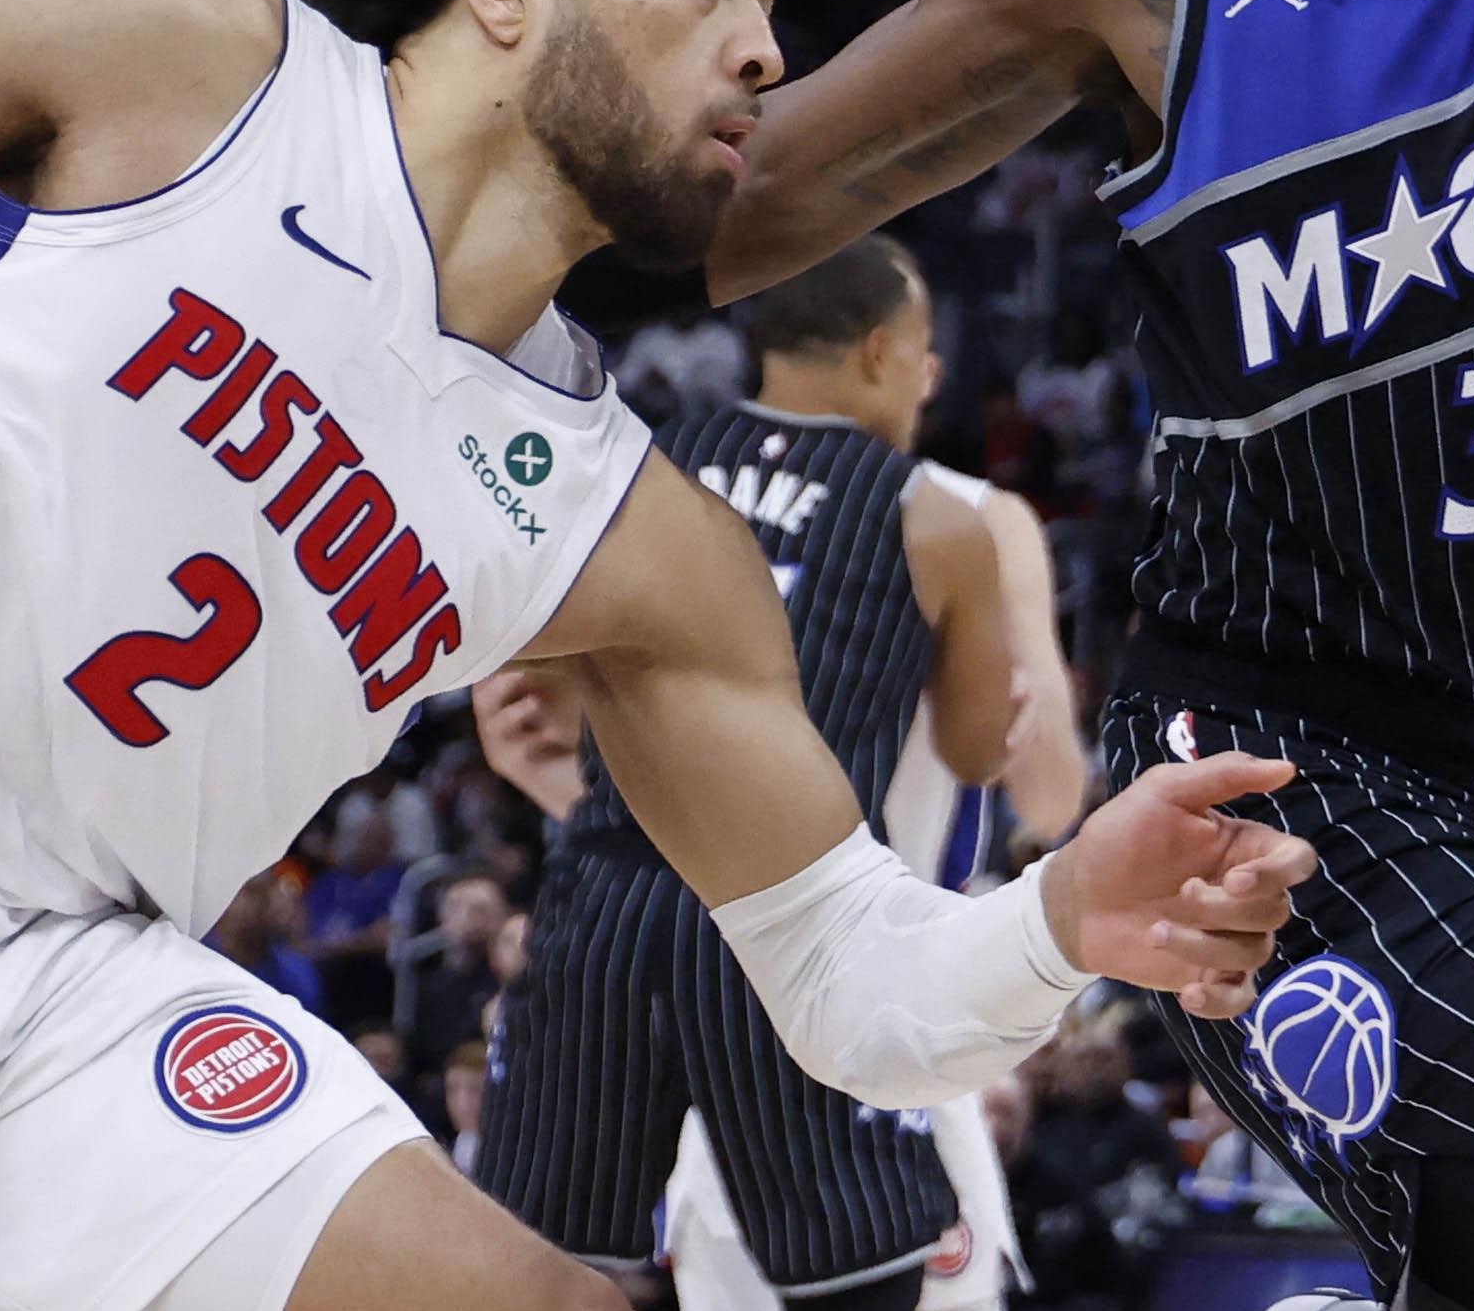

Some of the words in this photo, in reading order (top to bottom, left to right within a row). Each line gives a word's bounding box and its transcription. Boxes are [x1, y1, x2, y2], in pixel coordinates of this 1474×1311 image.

[105, 286, 462, 714] PISTONS
[63, 552, 264, 748] 2
[181, 1031, 264, 1088] DETROIT
[195, 1047, 282, 1106] PISTONS
